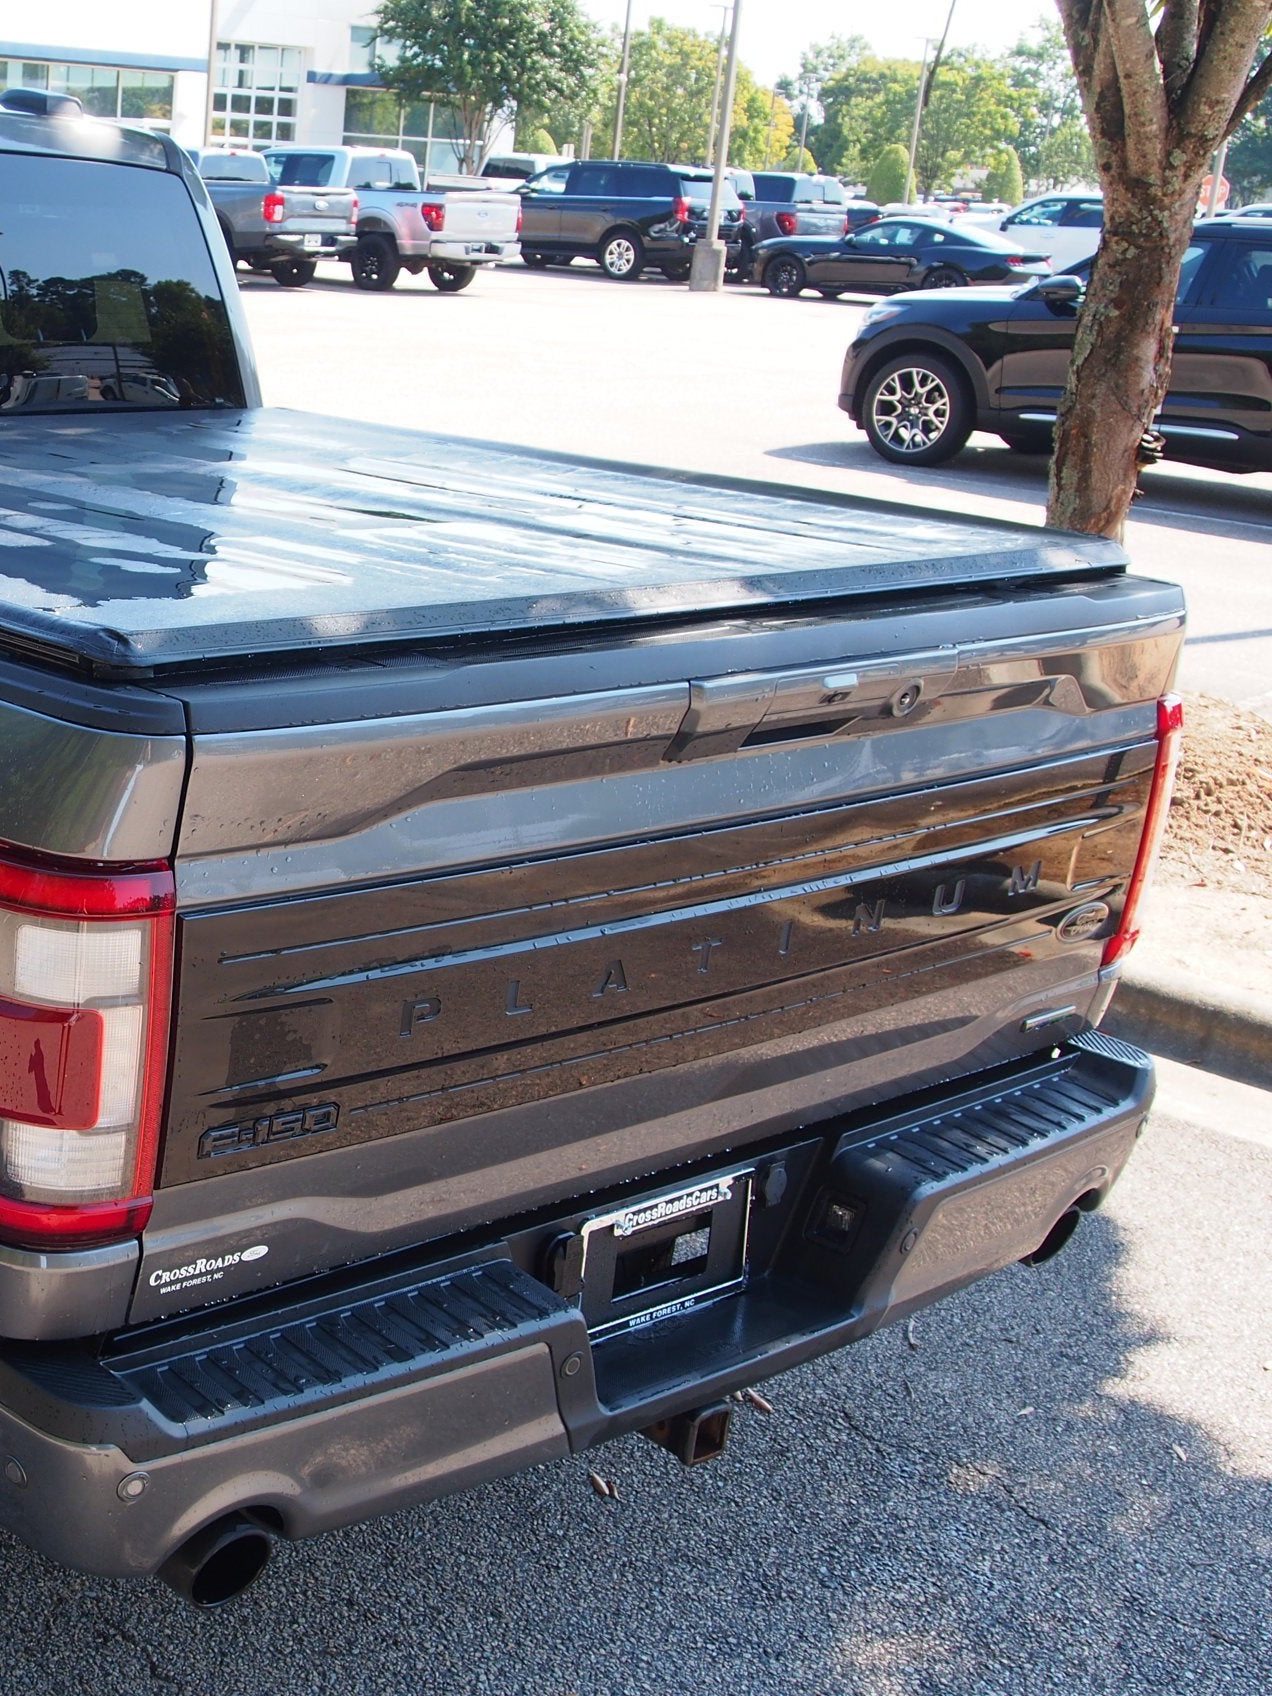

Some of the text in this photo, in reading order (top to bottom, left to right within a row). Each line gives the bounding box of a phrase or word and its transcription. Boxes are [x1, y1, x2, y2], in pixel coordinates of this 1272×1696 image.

[1200, 185, 1226, 198] STP
[400, 860, 1042, 1038] PLATINUM
[197, 1101, 340, 1160] F-150
[160, 1272, 224, 1294] WAKE FOREST, NC
[629, 1299, 695, 1326] WAKE FOREST, NC
